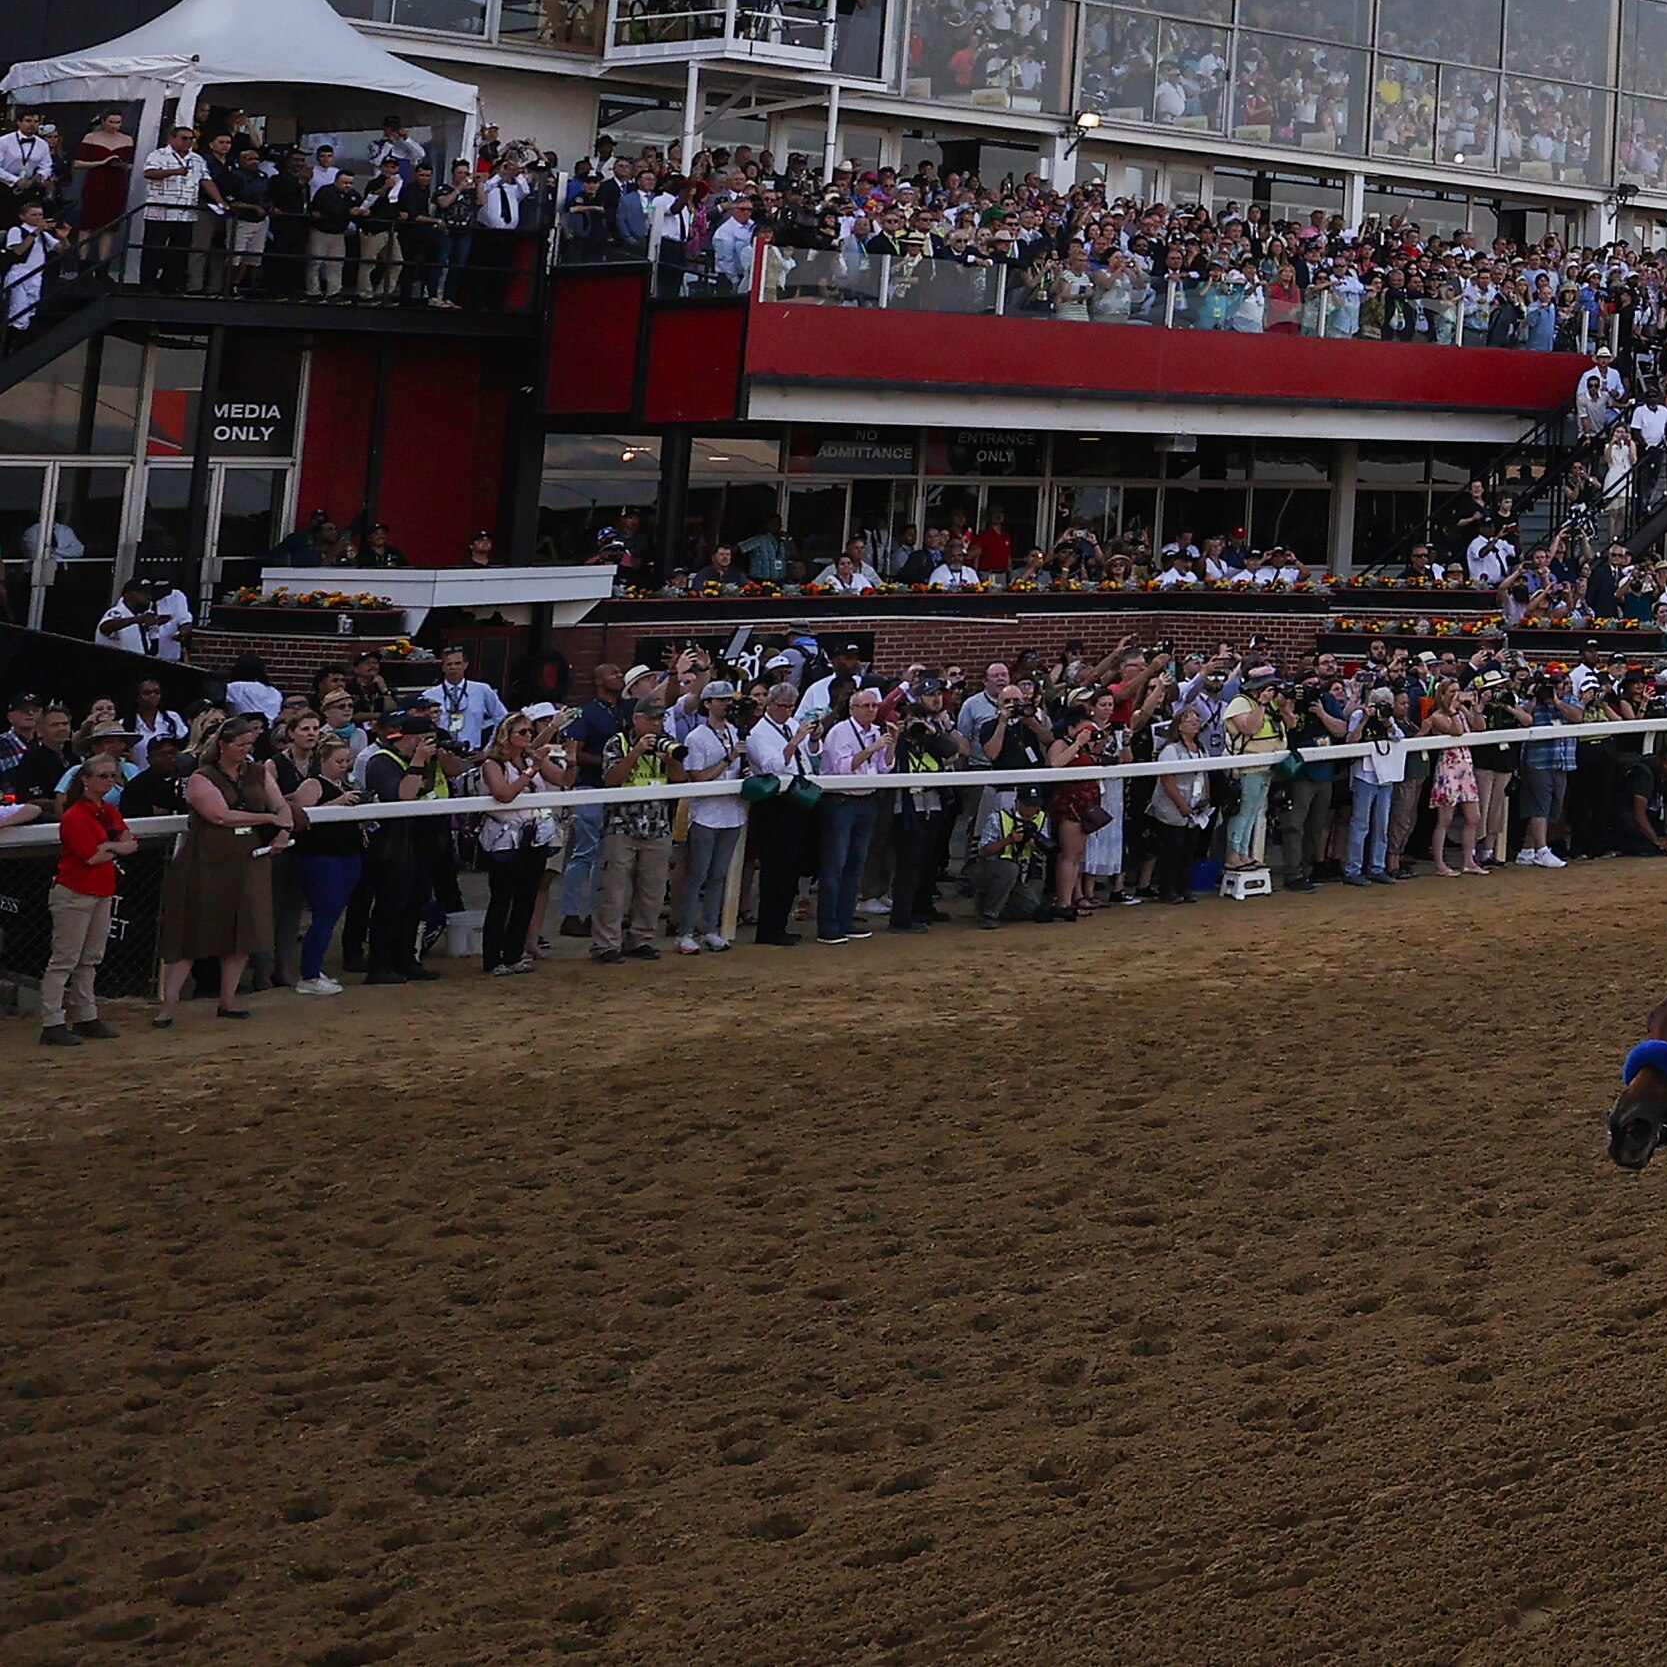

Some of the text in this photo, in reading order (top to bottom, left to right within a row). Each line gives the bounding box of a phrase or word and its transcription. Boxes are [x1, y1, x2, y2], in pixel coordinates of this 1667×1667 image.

[213, 403, 282, 420] MEDIA
[213, 425, 277, 441] ONLY
[855, 429, 878, 442] NO
[957, 432, 1036, 446] ENTRANCE
[816, 445, 914, 461] ADMITTANCE
[976, 449, 1015, 463] ONLY
[109, 917, 131, 941] ET
